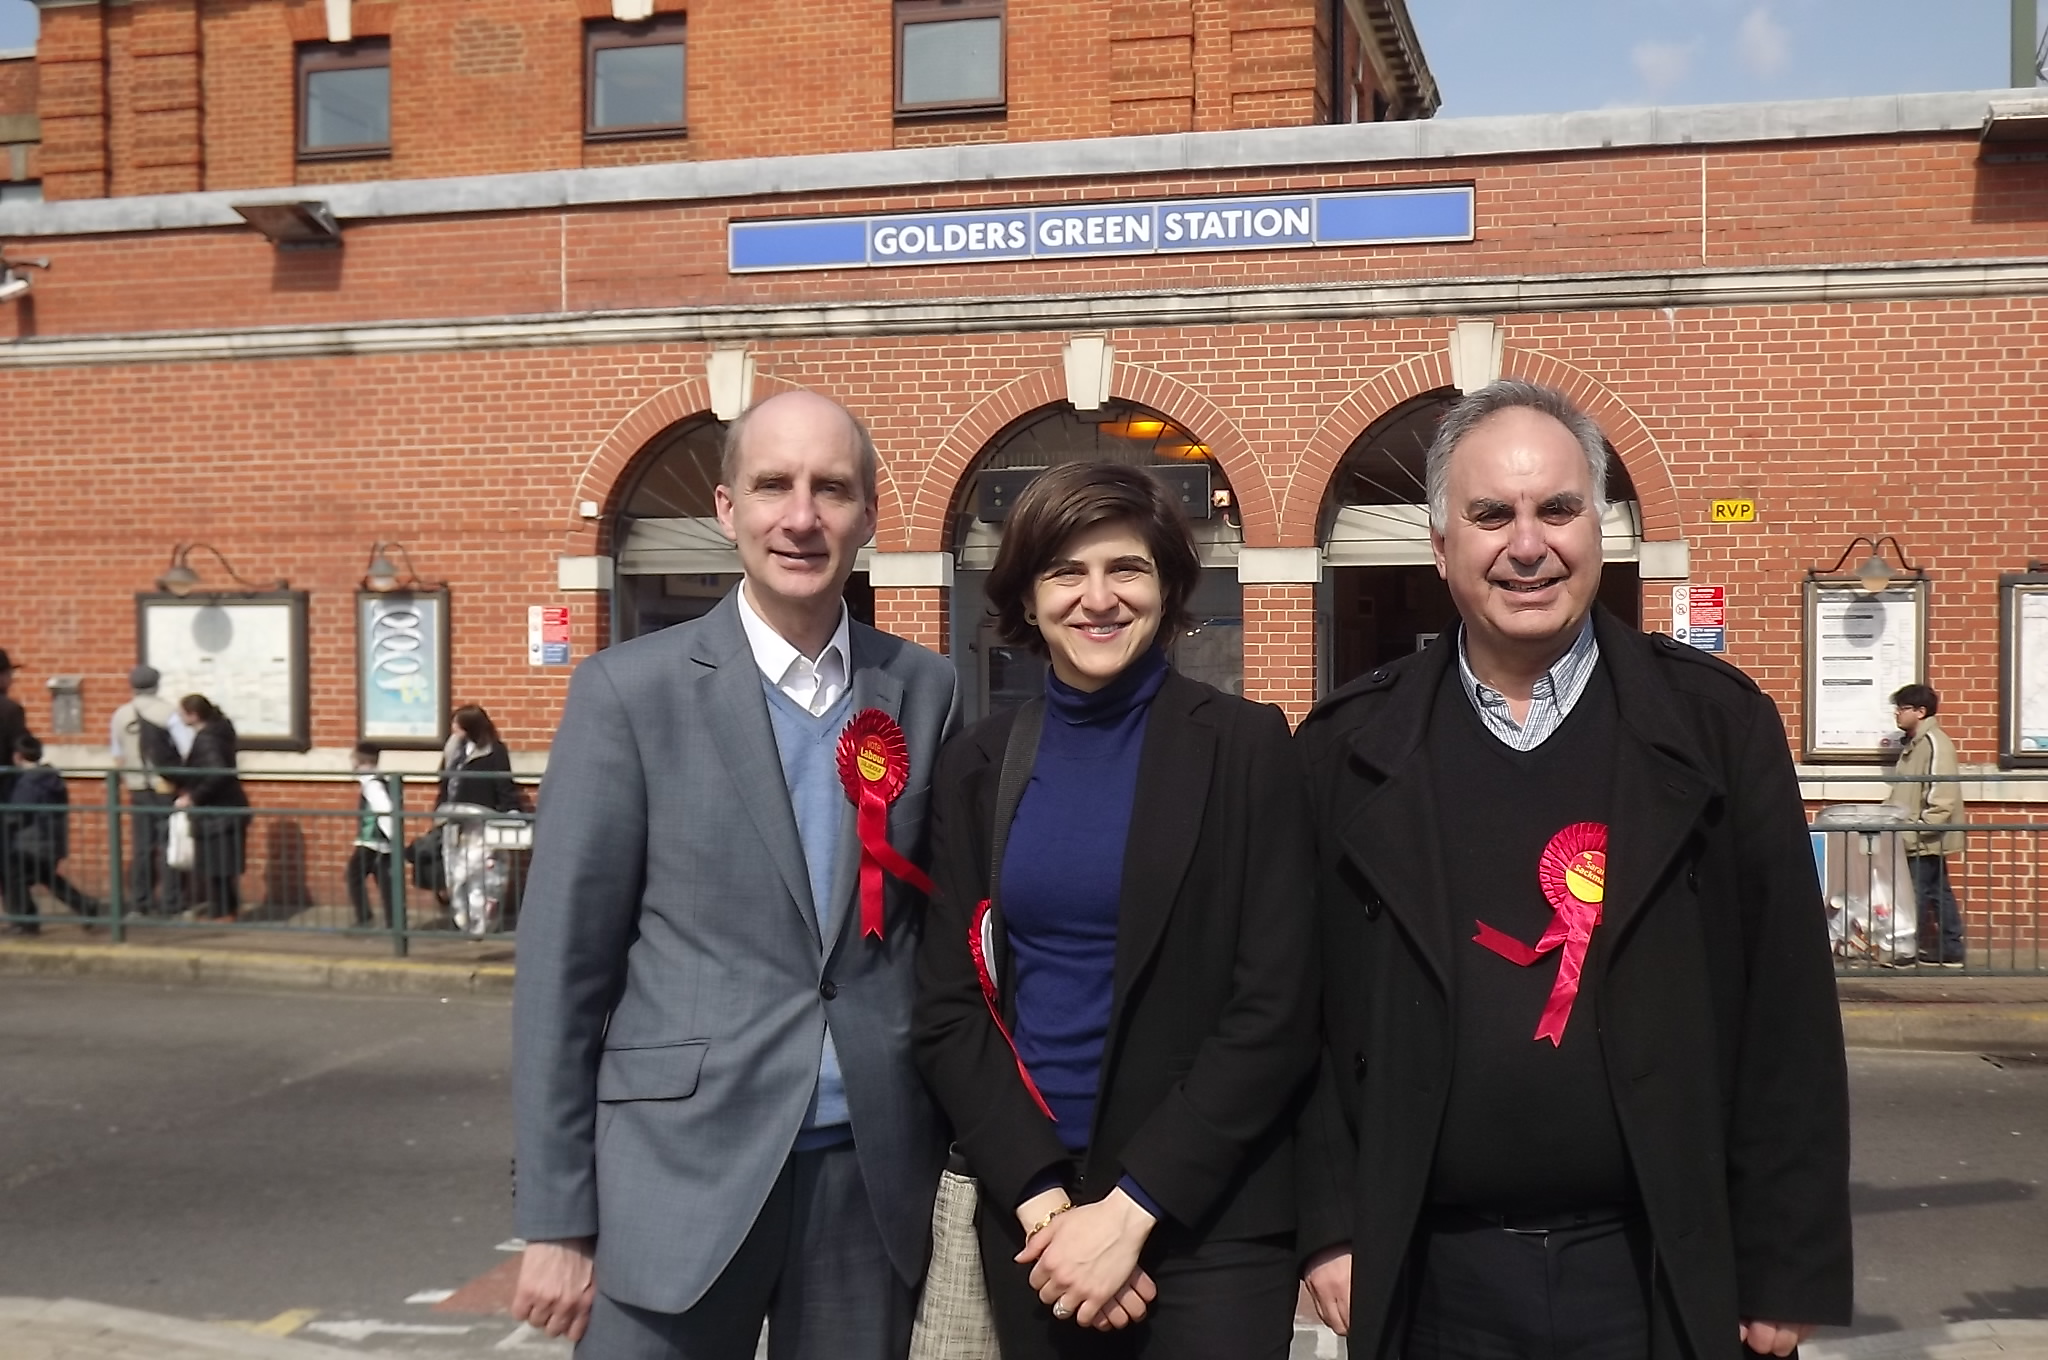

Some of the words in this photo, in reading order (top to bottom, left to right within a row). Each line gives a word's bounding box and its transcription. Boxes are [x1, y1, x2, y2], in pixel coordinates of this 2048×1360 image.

[874, 220, 1026, 255] GOLDERS
[1039, 214, 1150, 247] GREEN
[1164, 207, 1310, 241] STATION
[1716, 504, 1751, 517] RVP
[860, 746, 885, 765] Labour
[1574, 863, 1604, 885] Sackma
